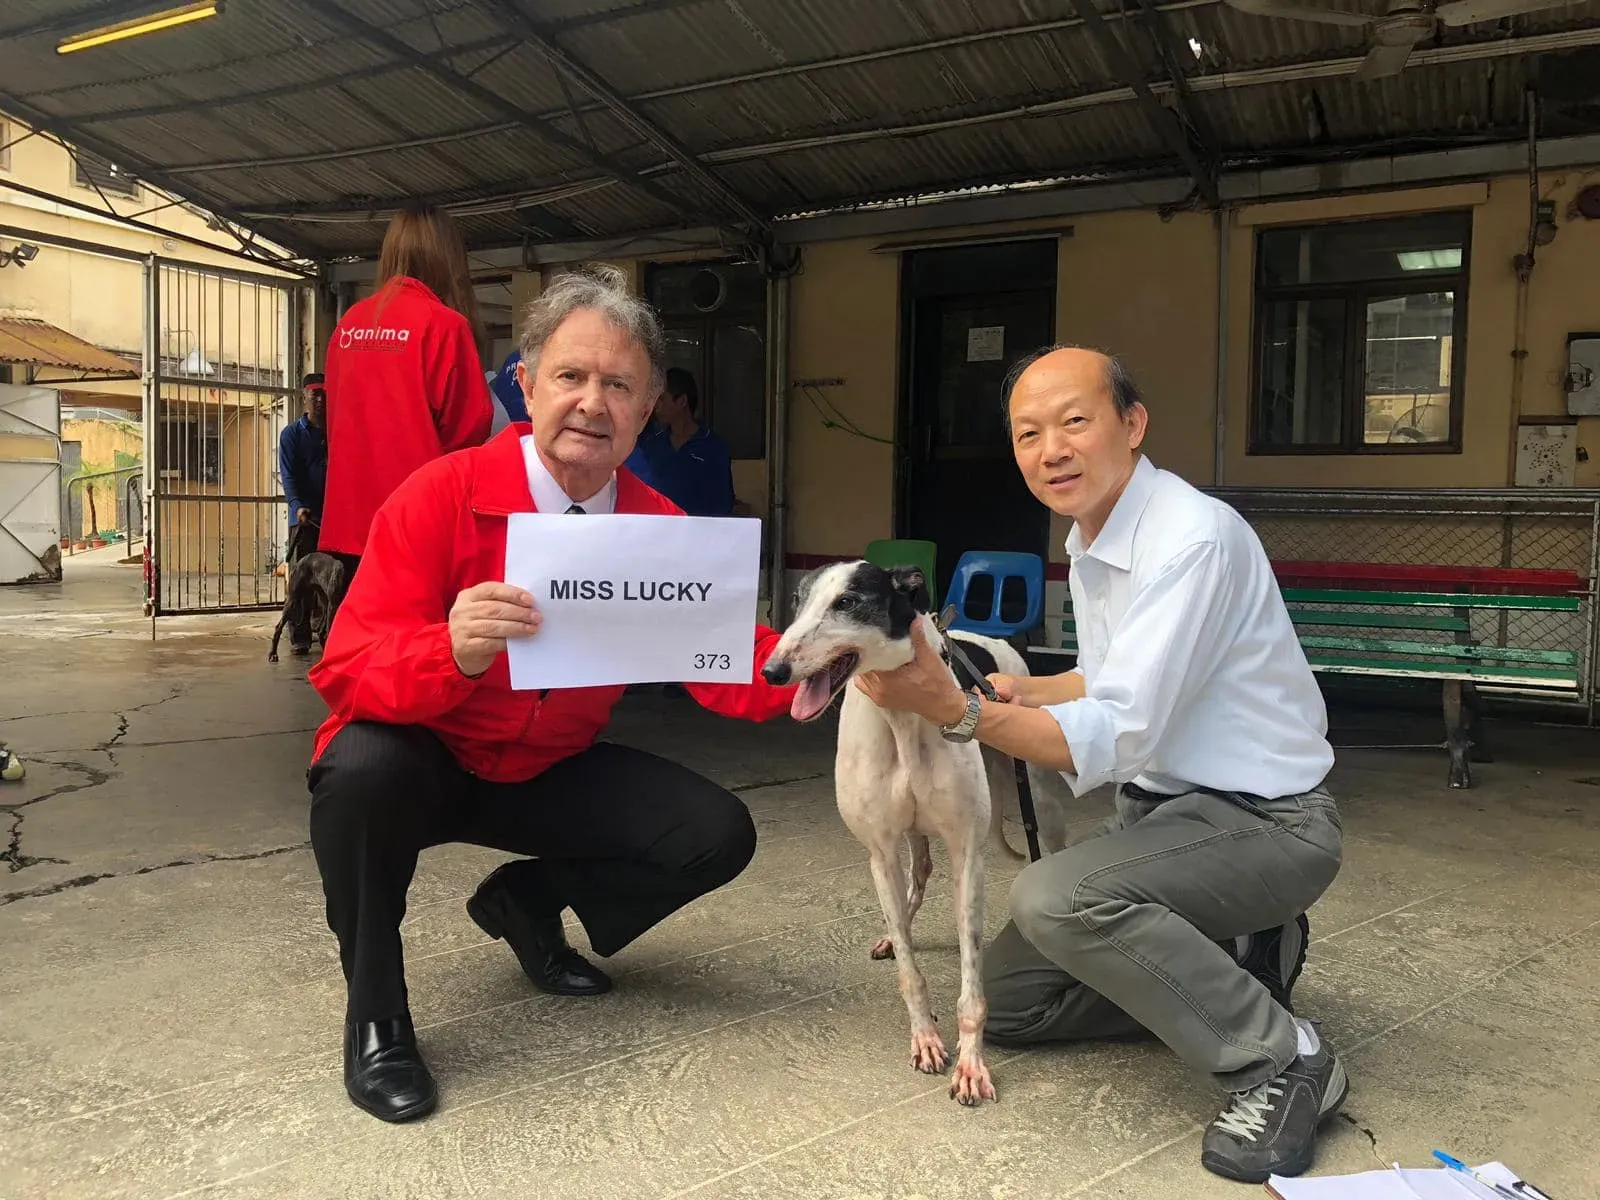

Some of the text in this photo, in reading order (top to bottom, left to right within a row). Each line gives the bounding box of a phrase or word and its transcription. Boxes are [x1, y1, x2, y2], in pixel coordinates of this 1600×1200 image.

[353, 326, 410, 342] anima
[550, 579, 713, 602] MISS LUCKY
[693, 653, 731, 670] 373
